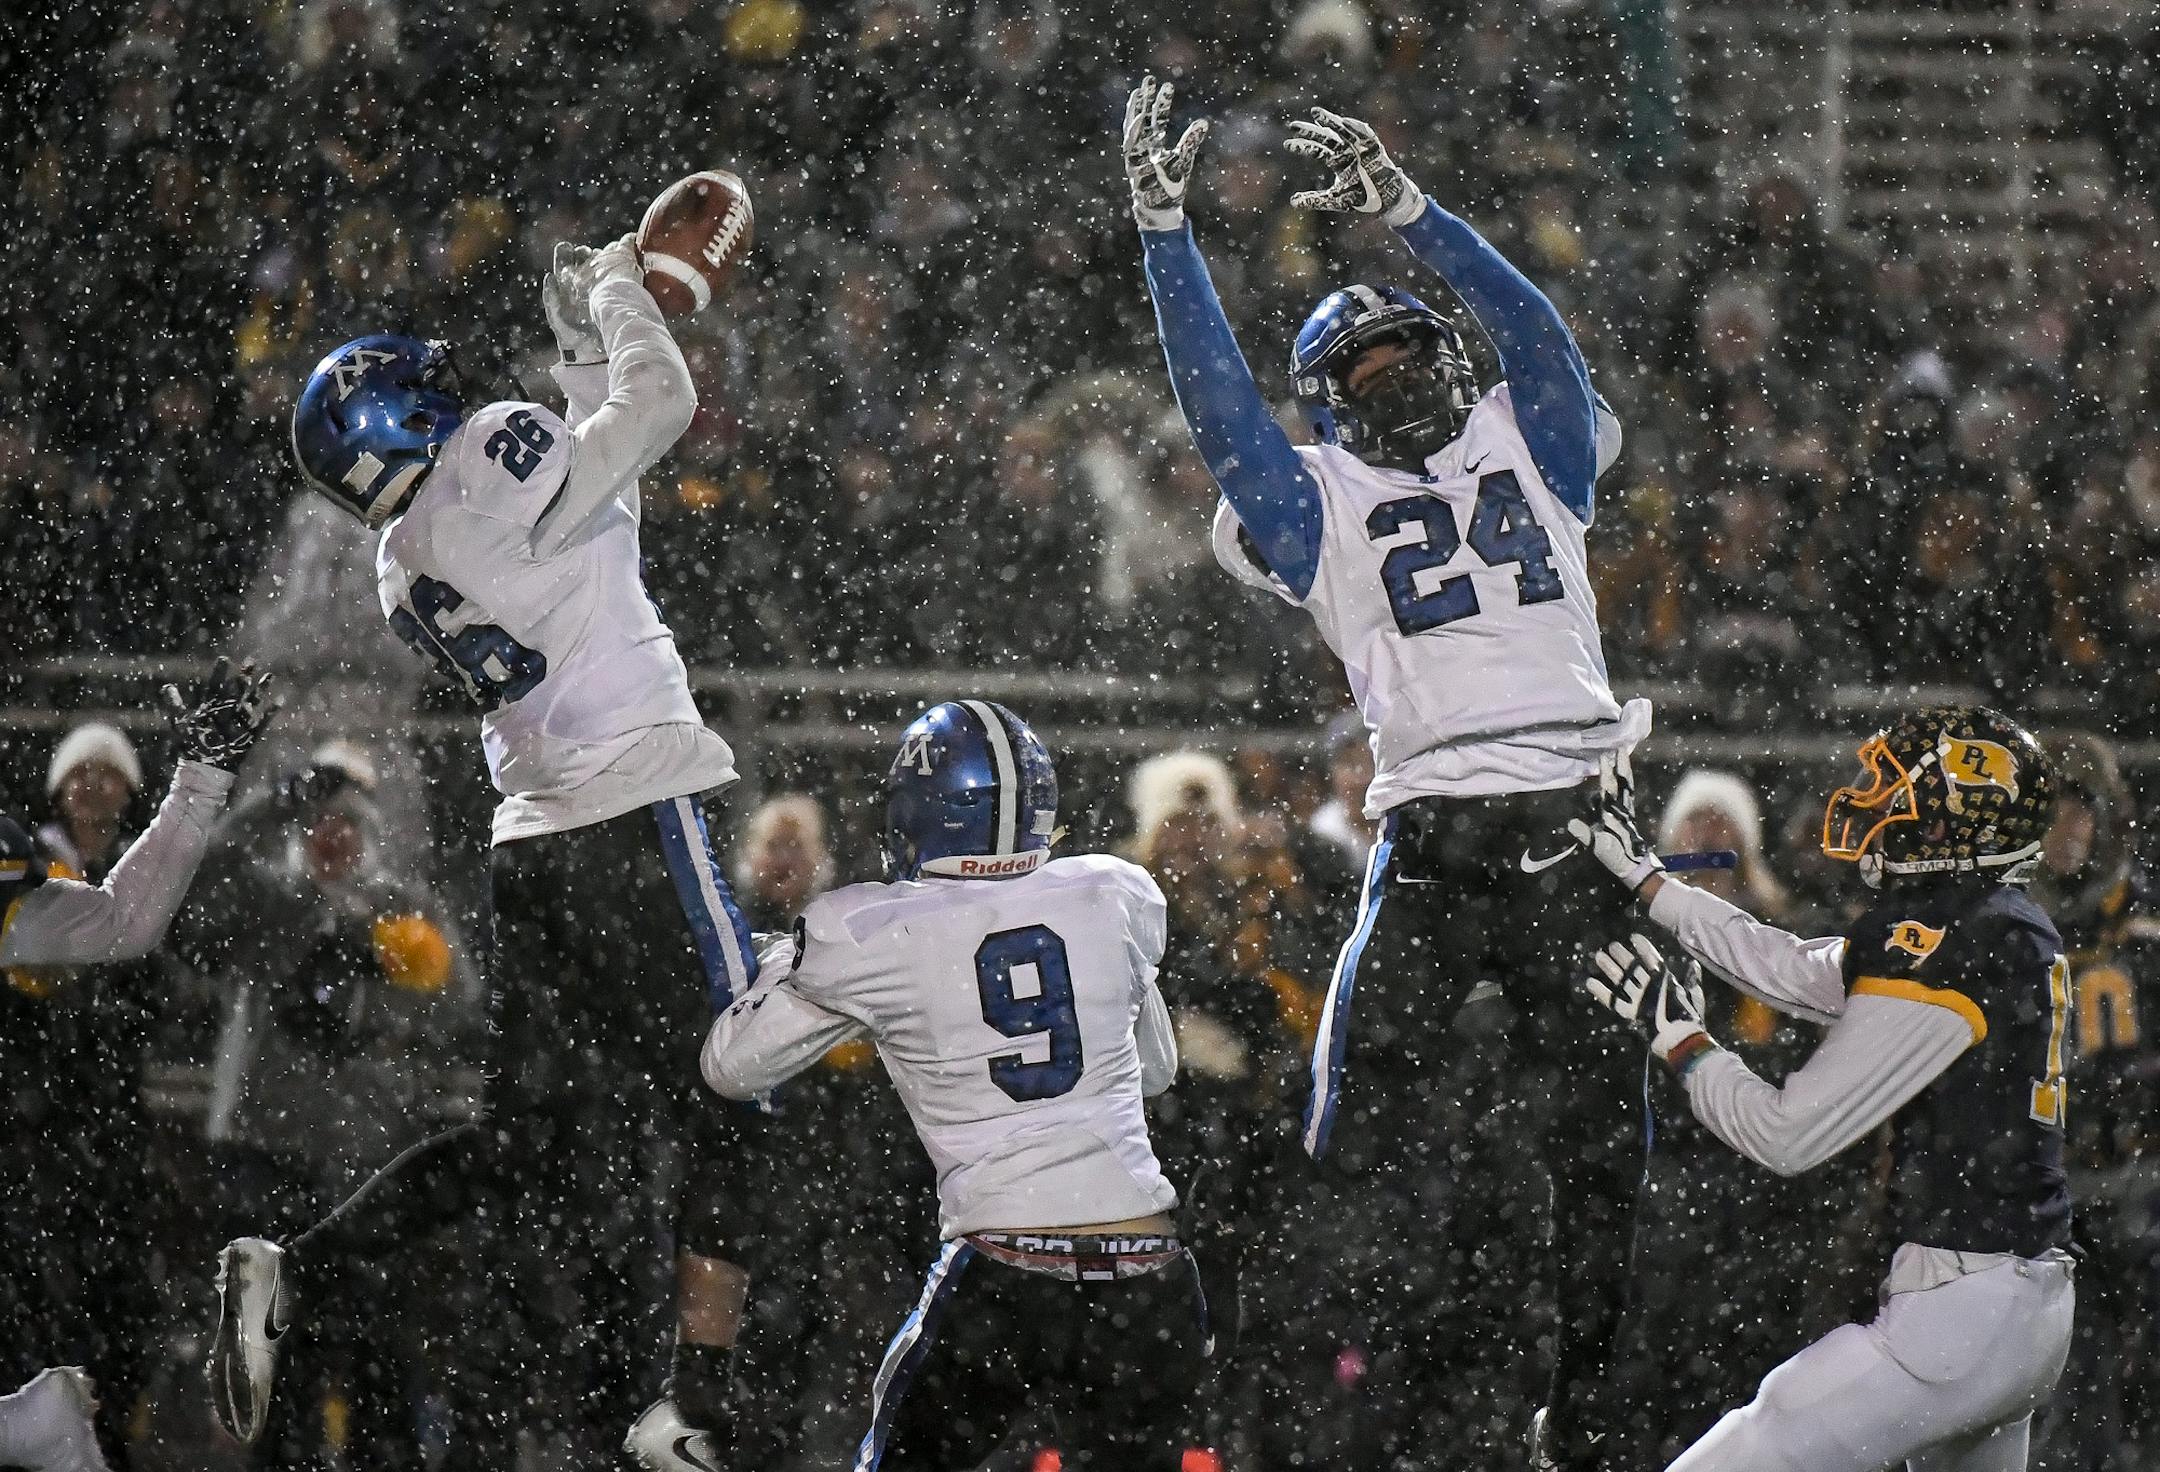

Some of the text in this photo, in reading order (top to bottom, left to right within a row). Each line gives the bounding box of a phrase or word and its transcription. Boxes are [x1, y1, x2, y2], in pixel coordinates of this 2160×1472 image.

[484, 410, 554, 483] 26
[1365, 468, 1565, 637] 24
[1961, 745, 1994, 779] PL
[960, 854, 1038, 875] Riddell
[1904, 928, 1925, 949] PL
[974, 922, 1085, 1103] 9
